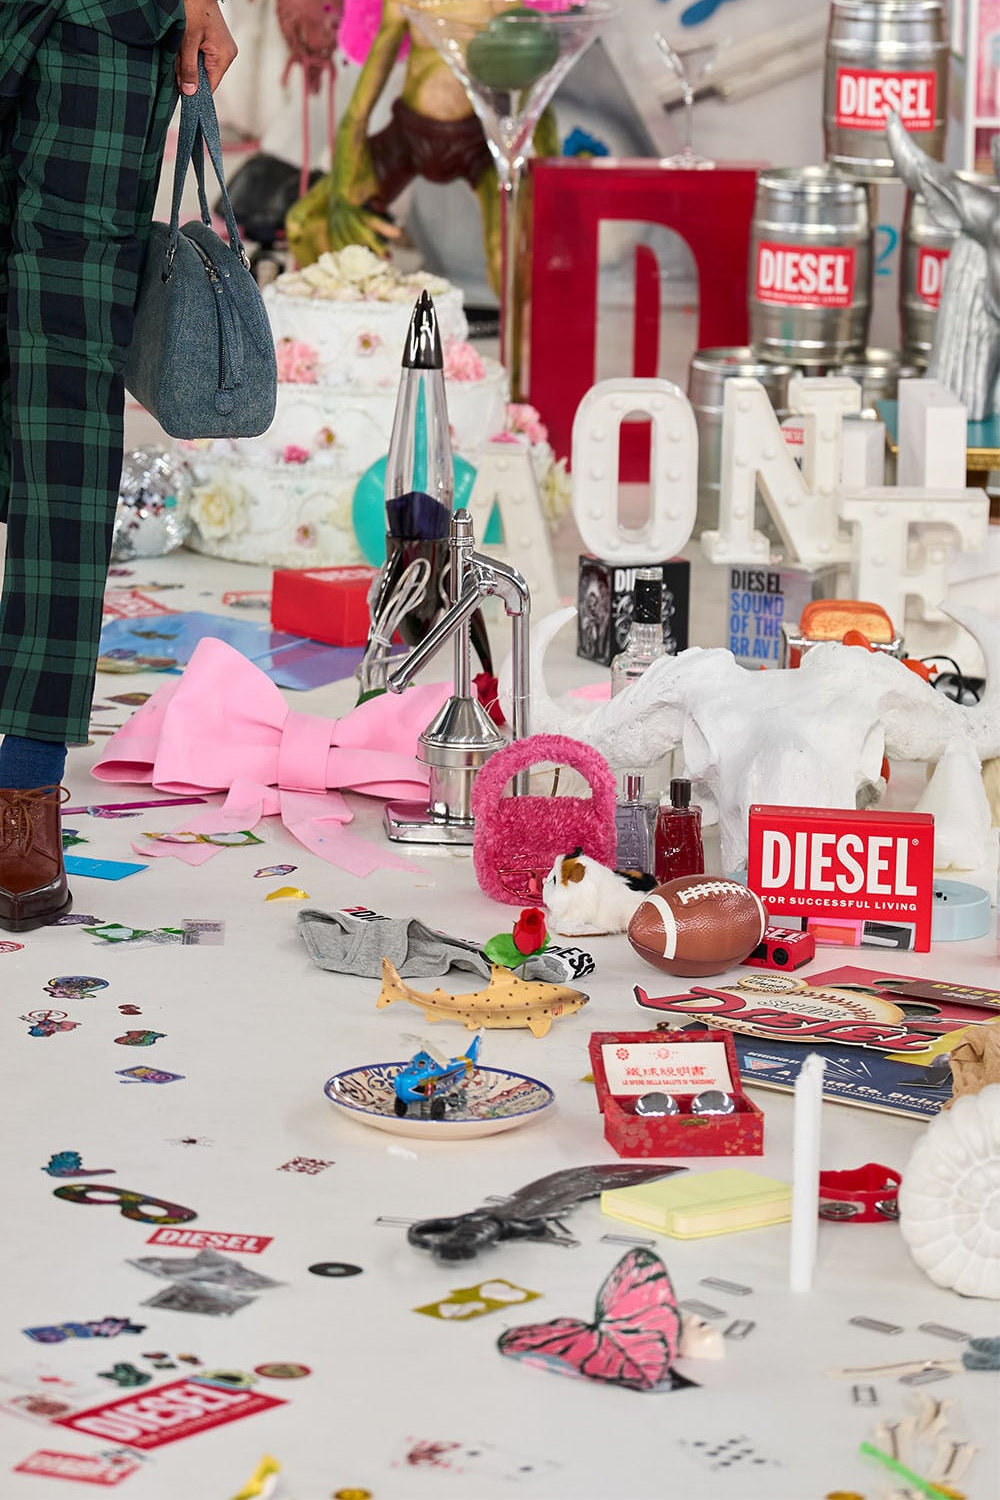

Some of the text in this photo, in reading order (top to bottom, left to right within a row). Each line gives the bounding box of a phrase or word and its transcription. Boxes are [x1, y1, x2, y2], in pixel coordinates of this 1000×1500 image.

[839, 75, 931, 119] DIESEL
[759, 248, 849, 294] DIESEL
[731, 569, 784, 595] DIESEL
[730, 591, 784, 617] SOUND
[730, 614, 782, 638] OF THE
[761, 895, 917, 911] FOR SUCCESSFUL LIVING
[155, 1230, 259, 1251] DIESEL
[74, 1384, 252, 1444] DIESEL
